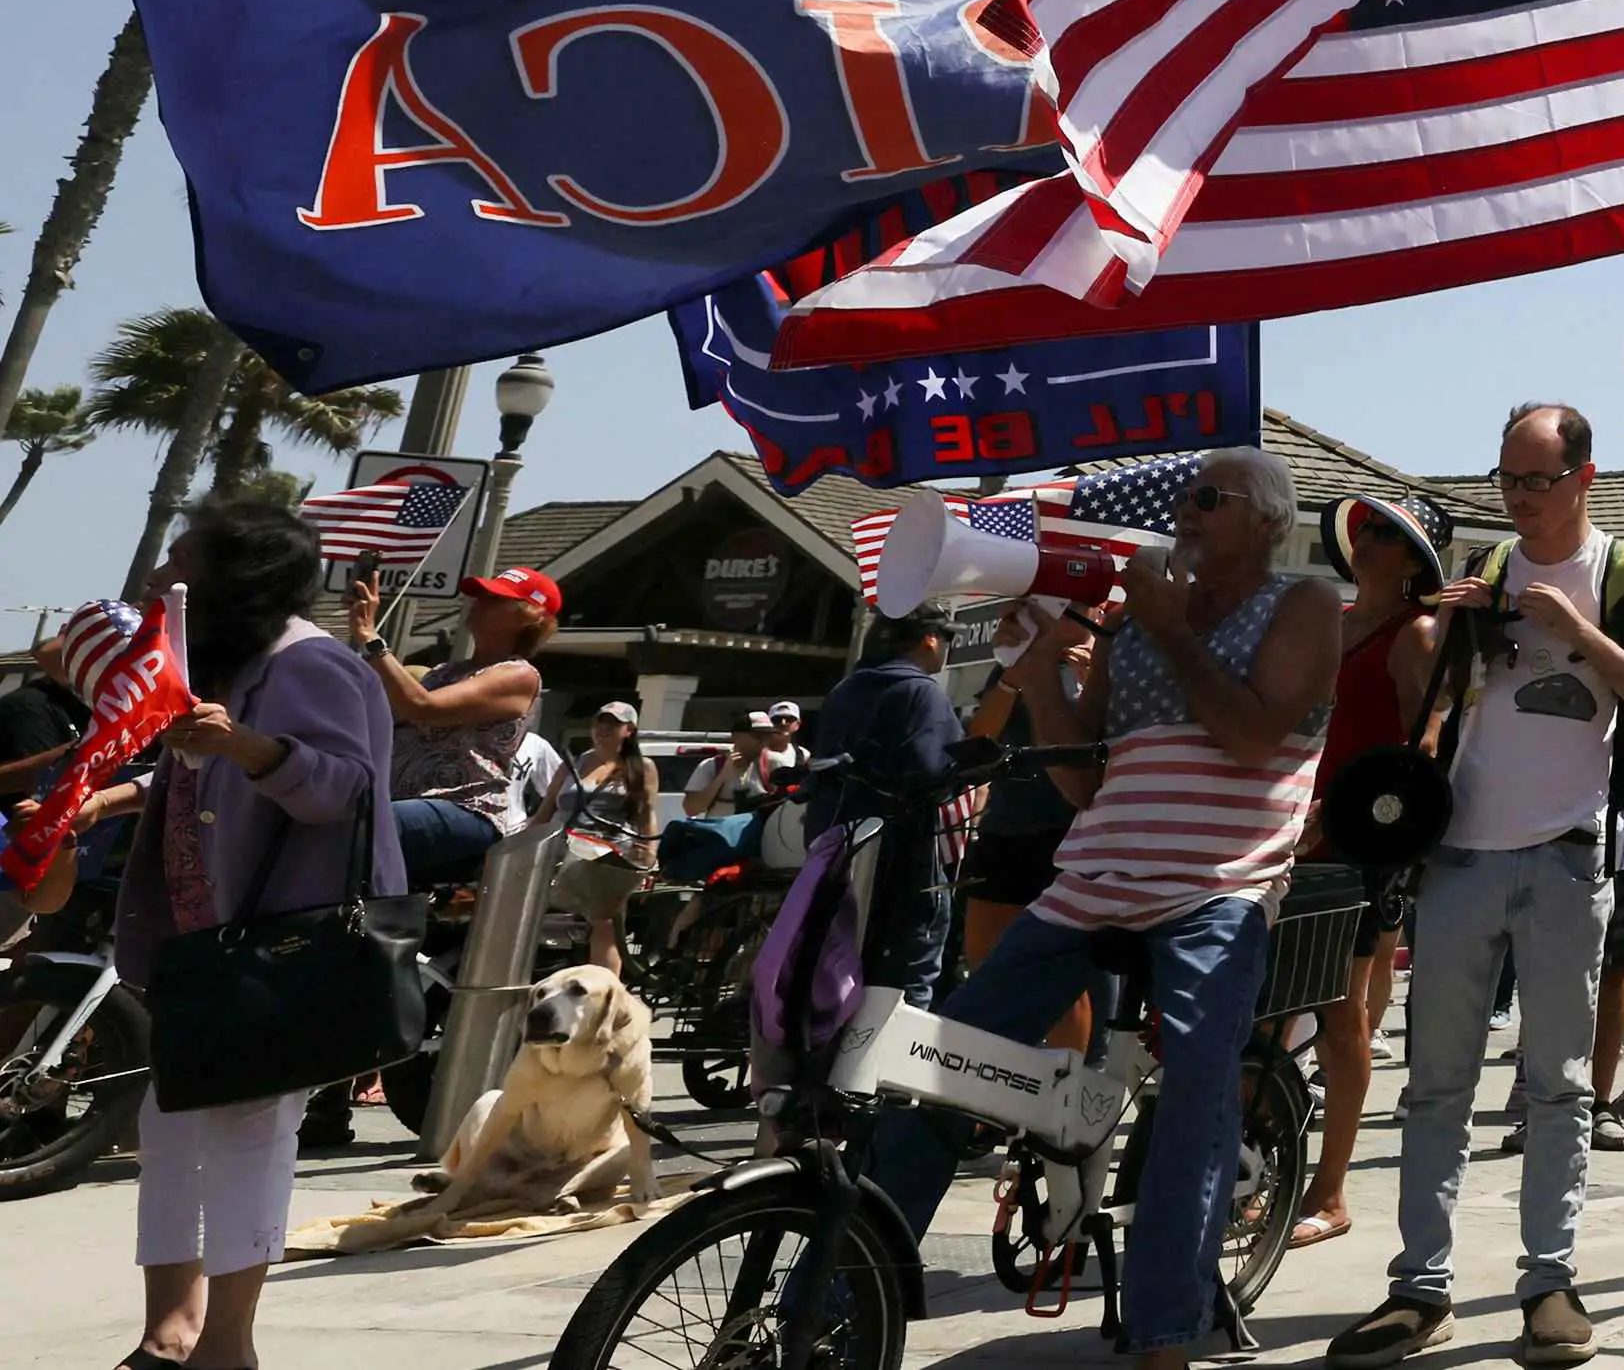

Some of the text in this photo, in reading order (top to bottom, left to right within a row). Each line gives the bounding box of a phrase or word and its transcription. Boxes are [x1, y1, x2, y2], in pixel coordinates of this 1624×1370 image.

[703, 554, 781, 580] DUKE'S
[74, 727, 133, 784] 2024
[29, 806, 76, 844] TAKE
[909, 1040, 1043, 1096] WIND HORSE
